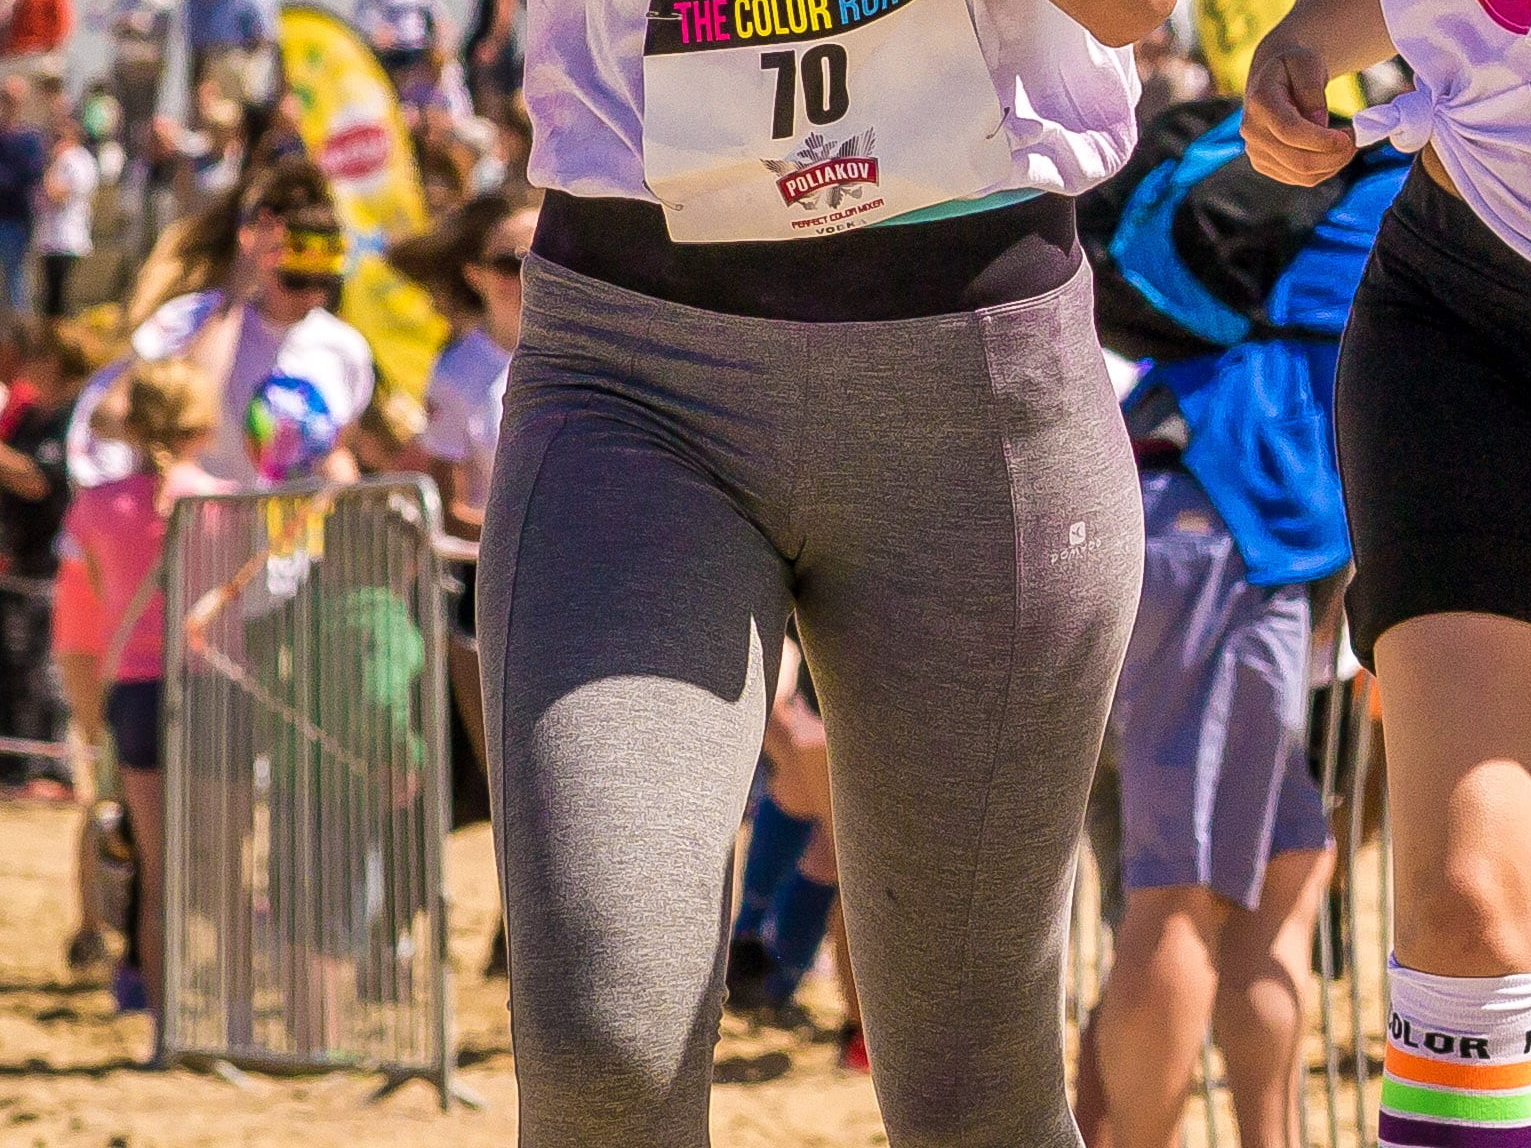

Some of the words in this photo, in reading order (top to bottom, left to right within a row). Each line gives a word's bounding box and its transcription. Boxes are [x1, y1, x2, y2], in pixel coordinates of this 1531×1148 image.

[760, 43, 849, 140] 70
[786, 162, 869, 197] POLIAKOV
[791, 215, 828, 230] PERFECT
[829, 207, 858, 222] COLOR
[860, 198, 885, 214] MIXER
